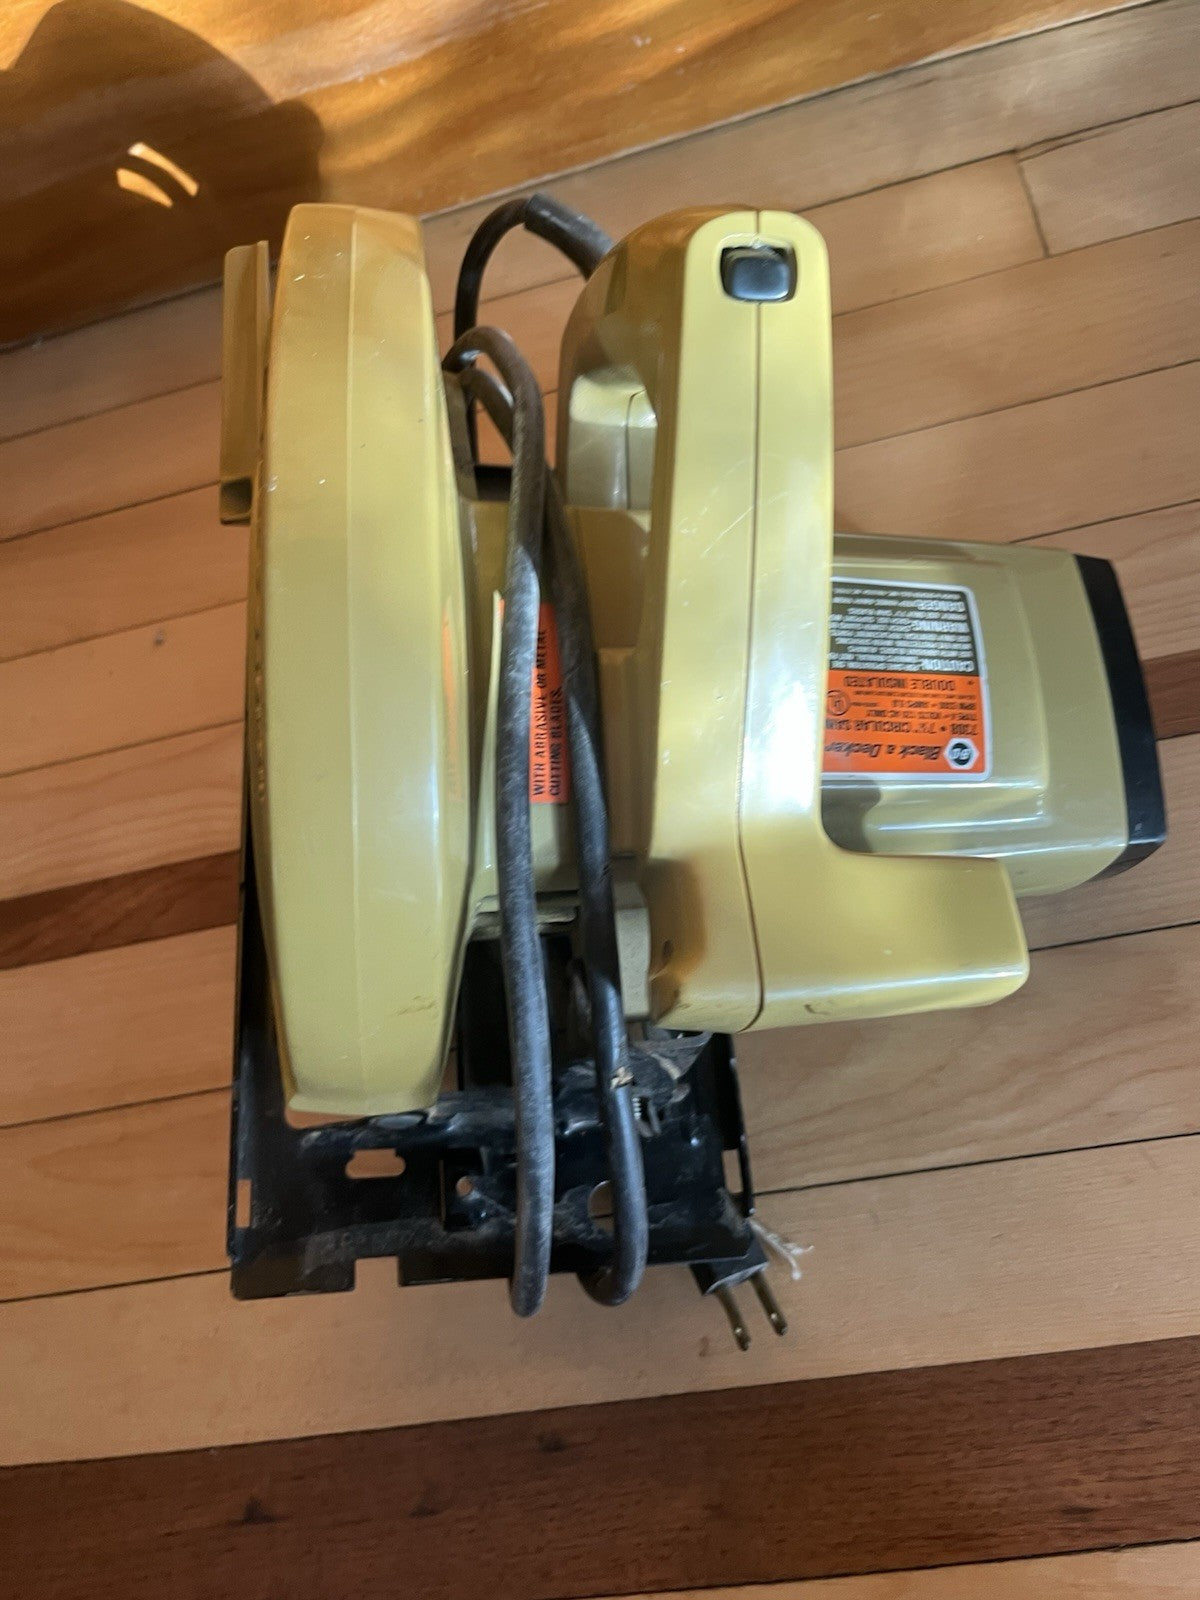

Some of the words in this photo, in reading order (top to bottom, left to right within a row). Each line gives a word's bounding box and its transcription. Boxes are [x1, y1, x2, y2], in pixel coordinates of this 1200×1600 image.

[536, 629, 546, 670] METAL
[537, 674, 546, 689] OR
[843, 676, 907, 689] INSULATED
[912, 679, 955, 691] DOUBLE
[534, 695, 547, 758] ABRASIVE
[855, 720, 911, 733] CIRCULAR
[824, 742, 882, 758] Decker
[899, 746, 942, 760] Black
[549, 743, 562, 796] CUTTING
[533, 763, 544, 796] WITH
